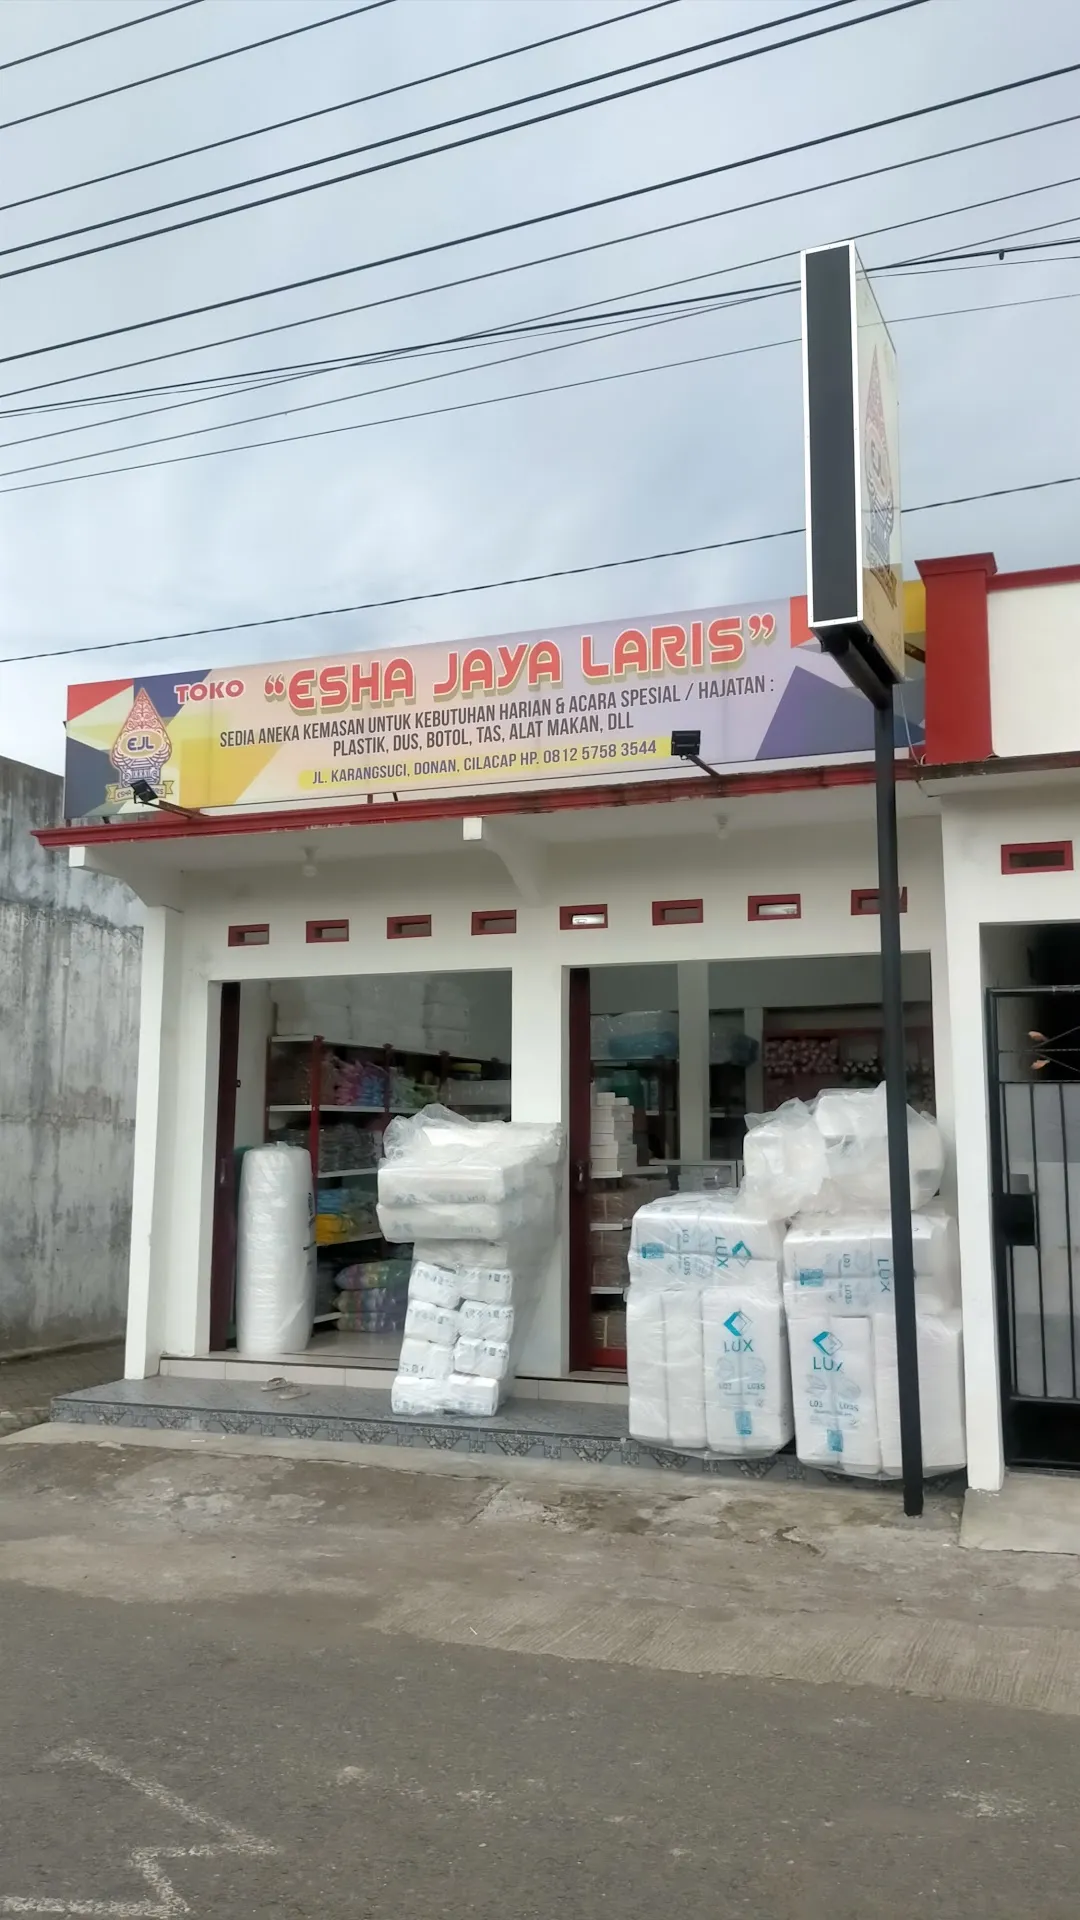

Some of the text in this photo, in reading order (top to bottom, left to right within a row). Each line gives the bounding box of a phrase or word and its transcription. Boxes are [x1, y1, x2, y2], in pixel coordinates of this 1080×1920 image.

[174, 679, 245, 704] TOKO
[433, 639, 562, 696] JAYA
[220, 729, 255, 747] SEDIA
[258, 725, 300, 744] ANEKA
[303, 718, 364, 740] KEMASAN
[368, 713, 411, 733] UNTUK
[415, 705, 495, 729] KEBUTUHAN
[499, 699, 551, 720] HARIAN
[556, 697, 565, 714] &
[569, 691, 616, 713] ACARA
[621, 685, 680, 707] SPESIAL
[685, 683, 694, 700] /
[698, 675, 765, 699] HAJATAN
[127, 736, 154, 751] EJL
[333, 712, 634, 757] PLASTIK, DUS, BOTOL, TAS, ALAT MAKAN, DLL
[312, 740, 656, 785] JL. KARANGSUCI, DONAN, CILACAP HP. 0812 5758 3544
[715, 1236, 728, 1268] LUX
[878, 1259, 891, 1292] LUX
[724, 1339, 754, 1353] LUX
